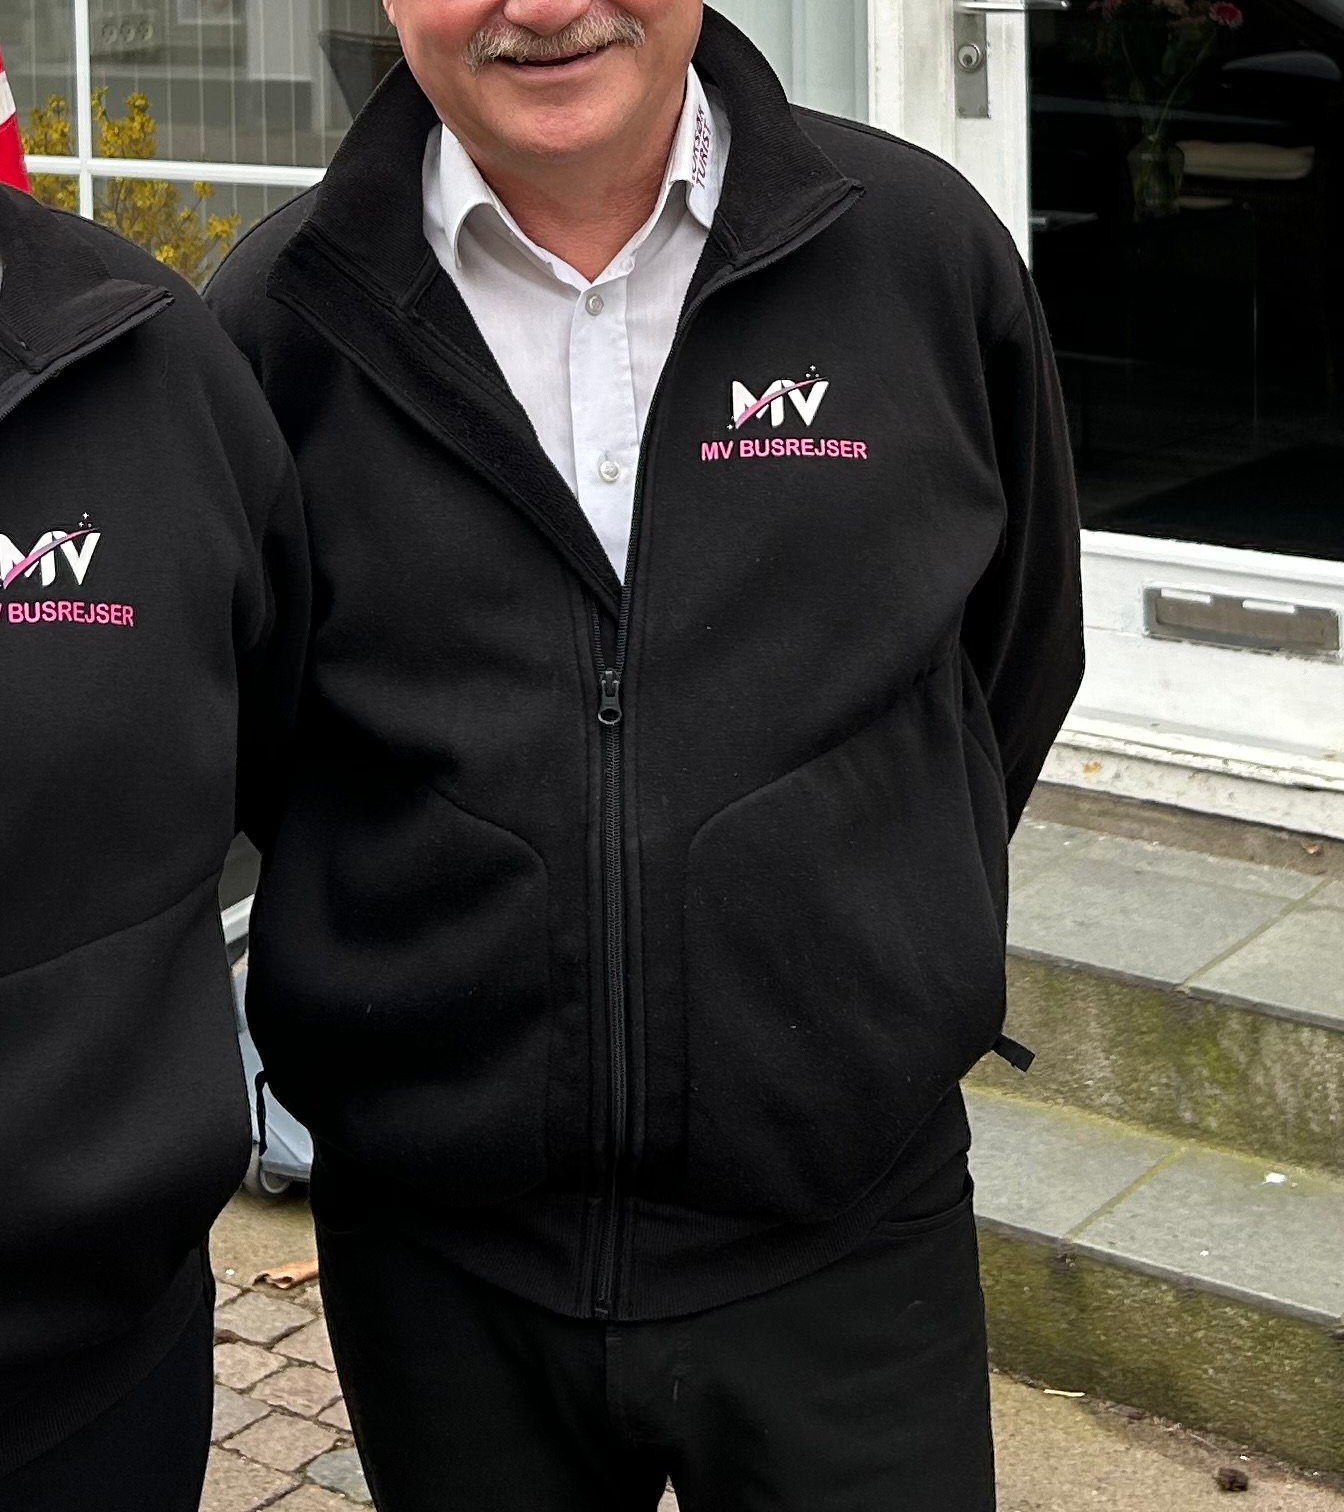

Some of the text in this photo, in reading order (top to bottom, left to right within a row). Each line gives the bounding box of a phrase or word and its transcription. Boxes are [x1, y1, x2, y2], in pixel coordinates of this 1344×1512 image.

[701, 438, 868, 462] MV BUSREJSER
[7, 600, 135, 627] BUSREJSER
